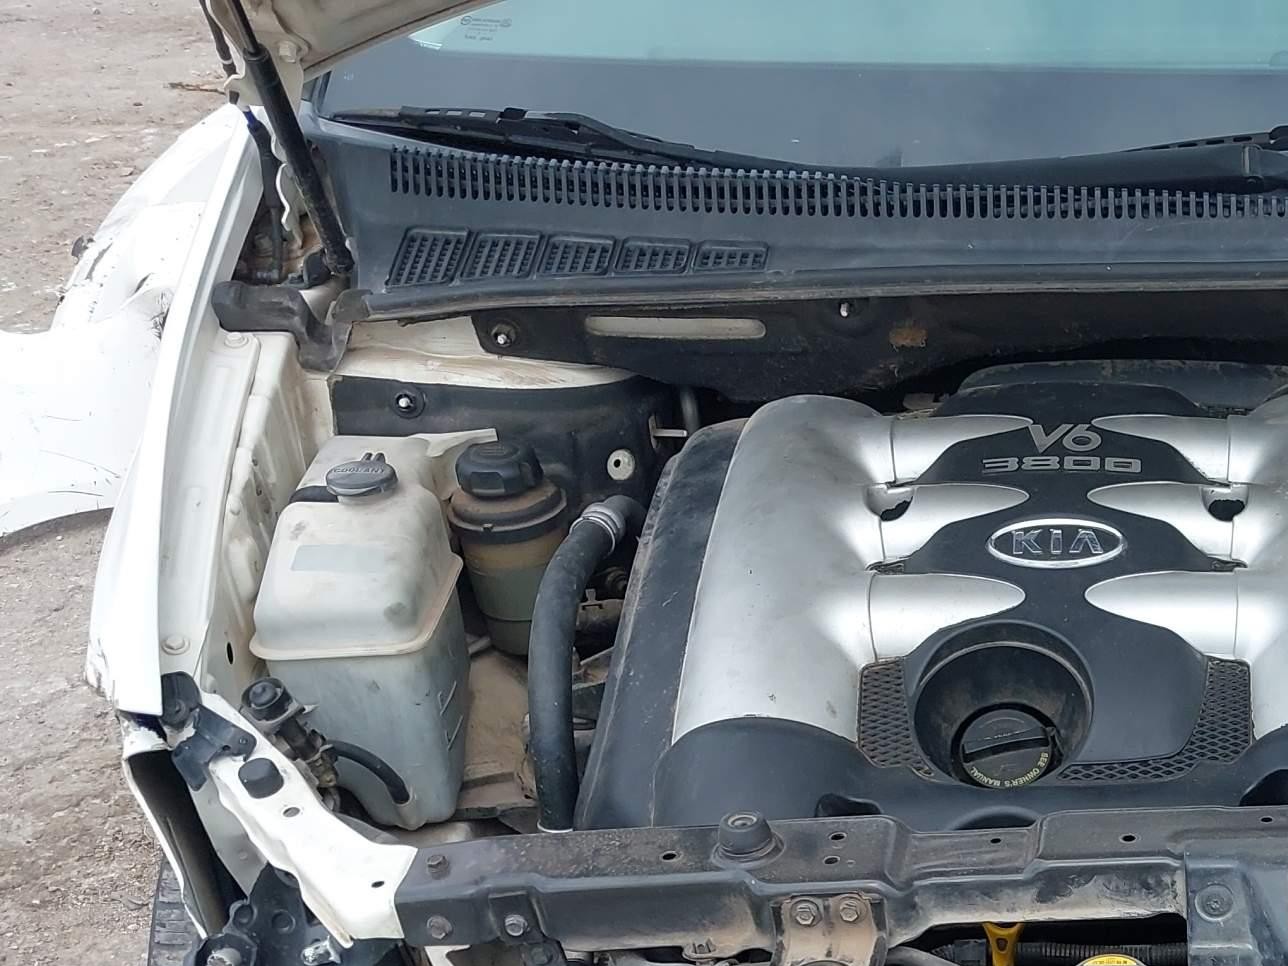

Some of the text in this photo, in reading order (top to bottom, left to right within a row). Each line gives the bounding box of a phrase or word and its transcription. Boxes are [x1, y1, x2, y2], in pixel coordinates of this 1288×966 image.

[1028, 423, 1102, 453] V6
[333, 466, 385, 475] COOLANT
[982, 456, 1142, 474] 3800
[1011, 528, 1104, 555] KIA
[969, 751, 1049, 788] SEE OWNER'S MANUAL
